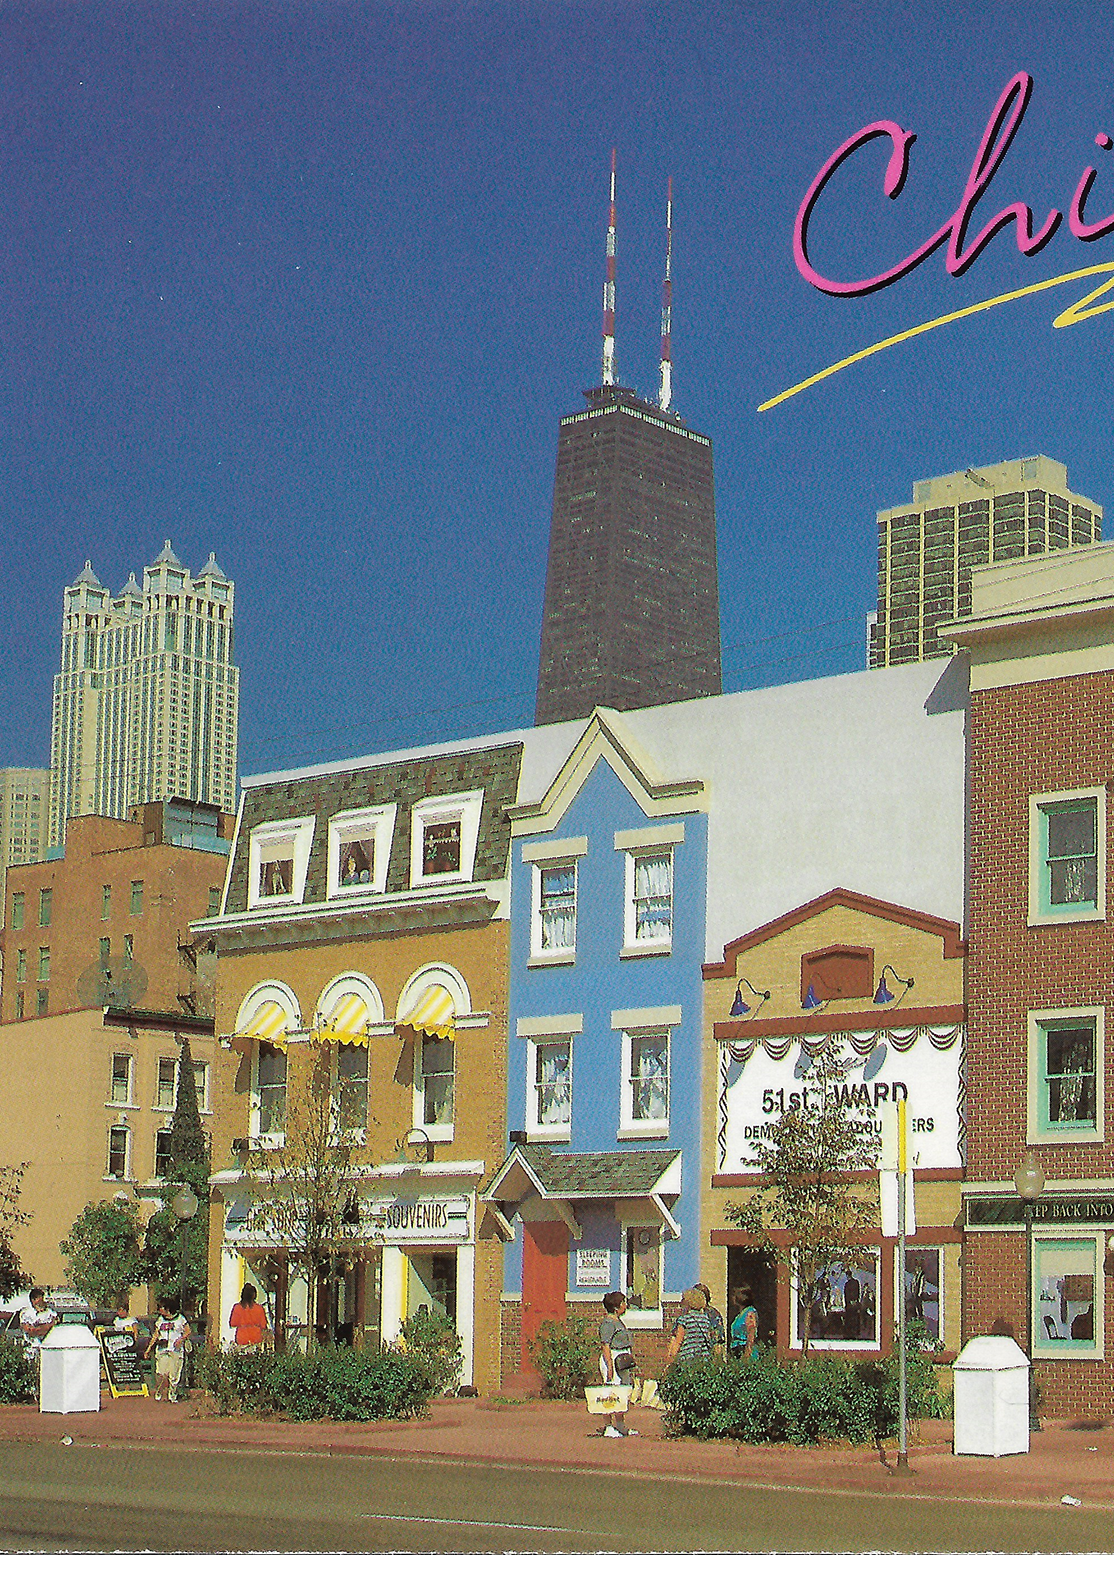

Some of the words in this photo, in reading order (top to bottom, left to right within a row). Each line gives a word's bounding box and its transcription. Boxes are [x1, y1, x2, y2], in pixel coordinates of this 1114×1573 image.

[386, 1203, 448, 1229] SOUVENIRS
[1052, 1203, 1082, 1217] BACK
[1086, 1203, 1114, 1217] INTO
